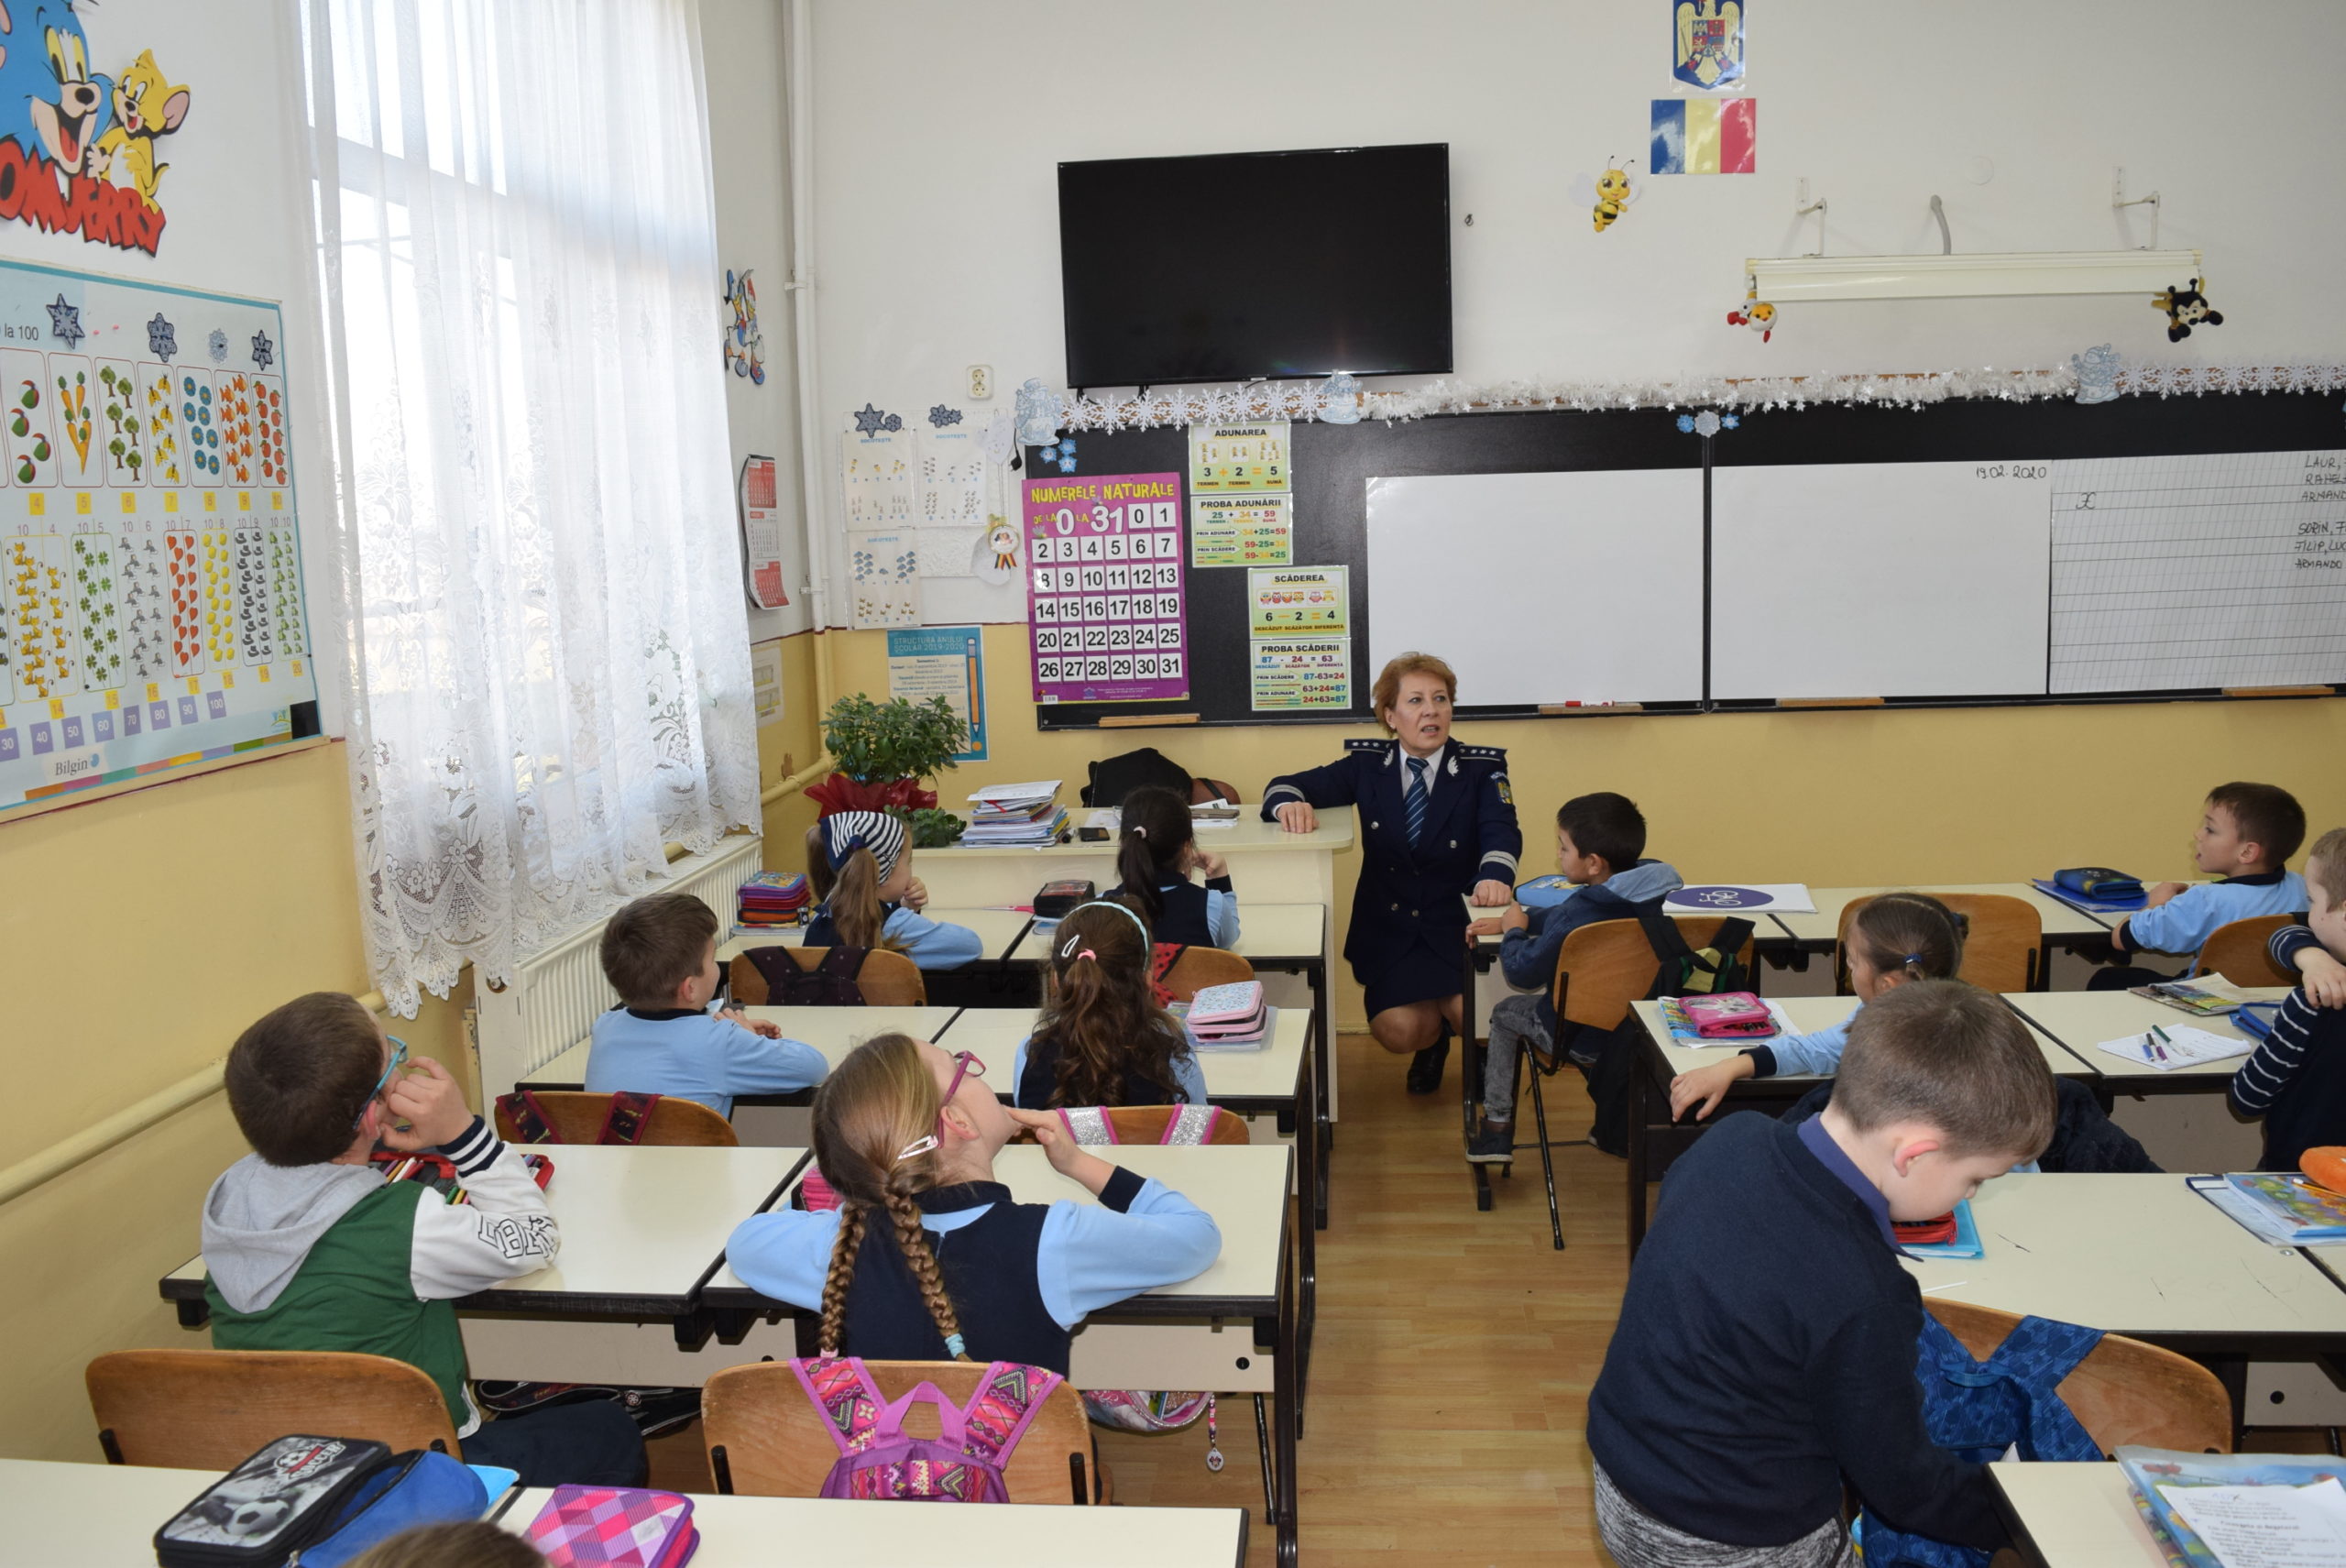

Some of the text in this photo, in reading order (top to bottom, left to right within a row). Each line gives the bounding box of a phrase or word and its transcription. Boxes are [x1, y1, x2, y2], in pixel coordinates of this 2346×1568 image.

[0, 140, 166, 258] OM JERRY
[5, 323, 38, 341] la 100
[1214, 428, 1266, 437] ADUNAREA
[1204, 467, 1211, 477] 3
[1235, 467, 1243, 477] 2
[1270, 466, 1277, 475] 5
[1031, 482, 1175, 503] NUMERELE NATURALE
[1200, 500, 1233, 509] PROBA
[237, 517, 258, 528] 10 9
[270, 516, 291, 527] 10 10
[1033, 505, 1124, 535] DE LA 0 LA 31
[1135, 508, 1167, 523] 0 1
[16, 523, 56, 536] 10 4
[77, 521, 104, 534] 10 5
[122, 520, 152, 532] 10 6
[166, 520, 191, 531] 10 7
[203, 518, 225, 529] 10 8
[1038, 538, 1170, 558] 2 3 4 5 6 7
[1065, 573, 1074, 587] 9
[1085, 572, 1102, 587] 10
[1109, 571, 1125, 586] 11
[1133, 569, 1152, 584] 12
[1157, 568, 1176, 583] 13
[1036, 598, 1178, 619] 14 15 16 17 18 19
[1266, 612, 1273, 621] 6
[1295, 611, 1302, 620] 2
[1327, 610, 1335, 620] 4
[1038, 628, 1179, 648] 20 21 22 23 24 25
[1040, 658, 1180, 677] 26 27 28 29 30 31
[2, 698, 224, 751] 30 40 50 60 70 80 90 100
[55, 758, 88, 776] Bilgin
